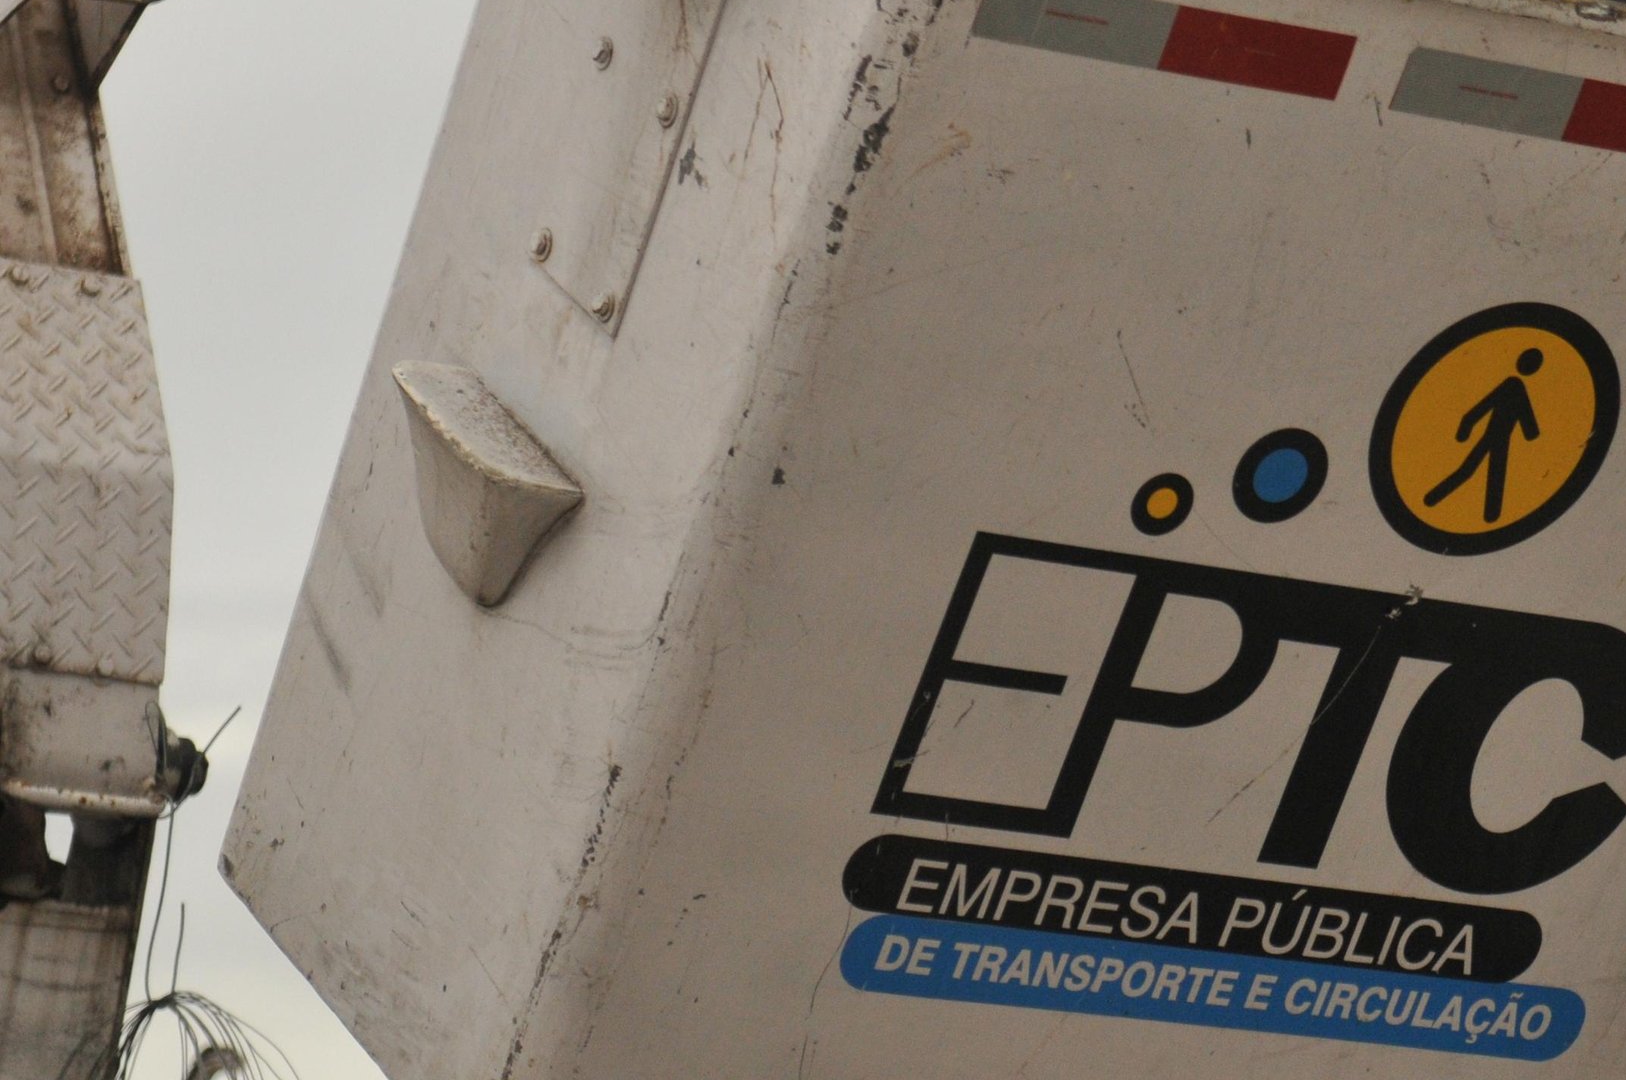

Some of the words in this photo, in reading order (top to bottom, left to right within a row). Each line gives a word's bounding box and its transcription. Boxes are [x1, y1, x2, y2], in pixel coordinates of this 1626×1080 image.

[897, 858, 1199, 944] EMPRESA
[1218, 889, 1475, 976] PÚBLICA
[874, 934, 942, 976] DE
[952, 942, 1240, 1007] TRANSPORTE
[1244, 974, 1279, 1011] E
[1284, 978, 1552, 1044] CIRCULAÇÃO
